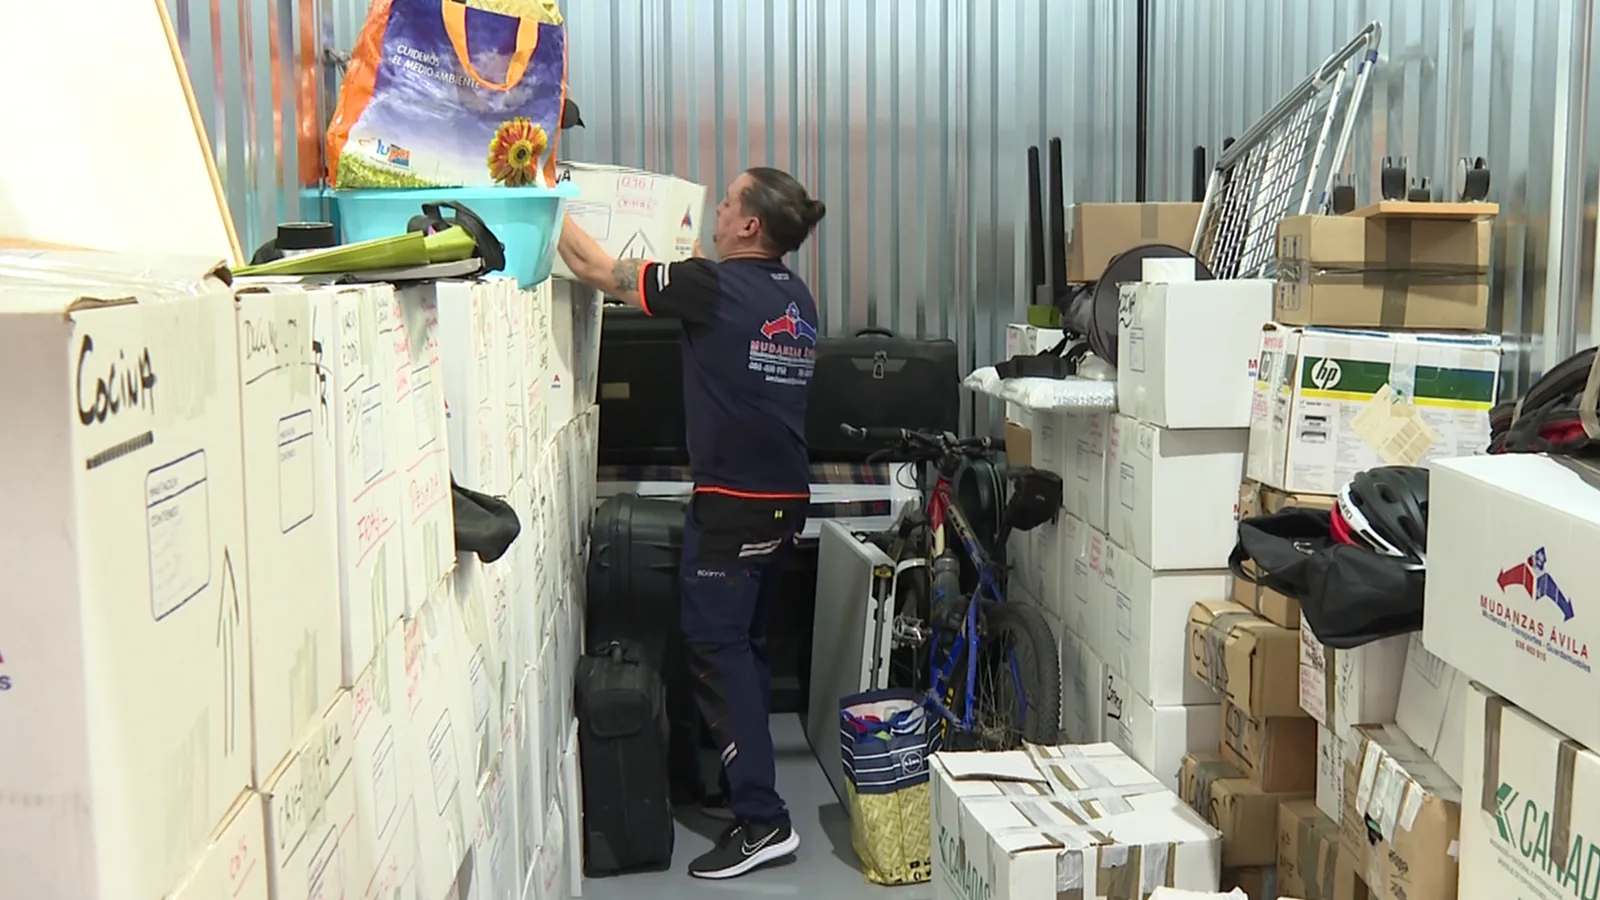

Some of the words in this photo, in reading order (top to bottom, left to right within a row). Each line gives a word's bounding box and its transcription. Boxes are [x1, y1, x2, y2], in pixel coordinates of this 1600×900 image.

[391, 54, 401, 66] EL
[403, 59, 434, 77] MEDIO
[435, 71, 480, 90] AMBIENTE
[397, 44, 440, 67] CUIDEMOS
[1314, 357, 1339, 391] hp
[1480, 594, 1545, 638] MUDANZAS
[1550, 625, 1589, 660] ÁVILA
